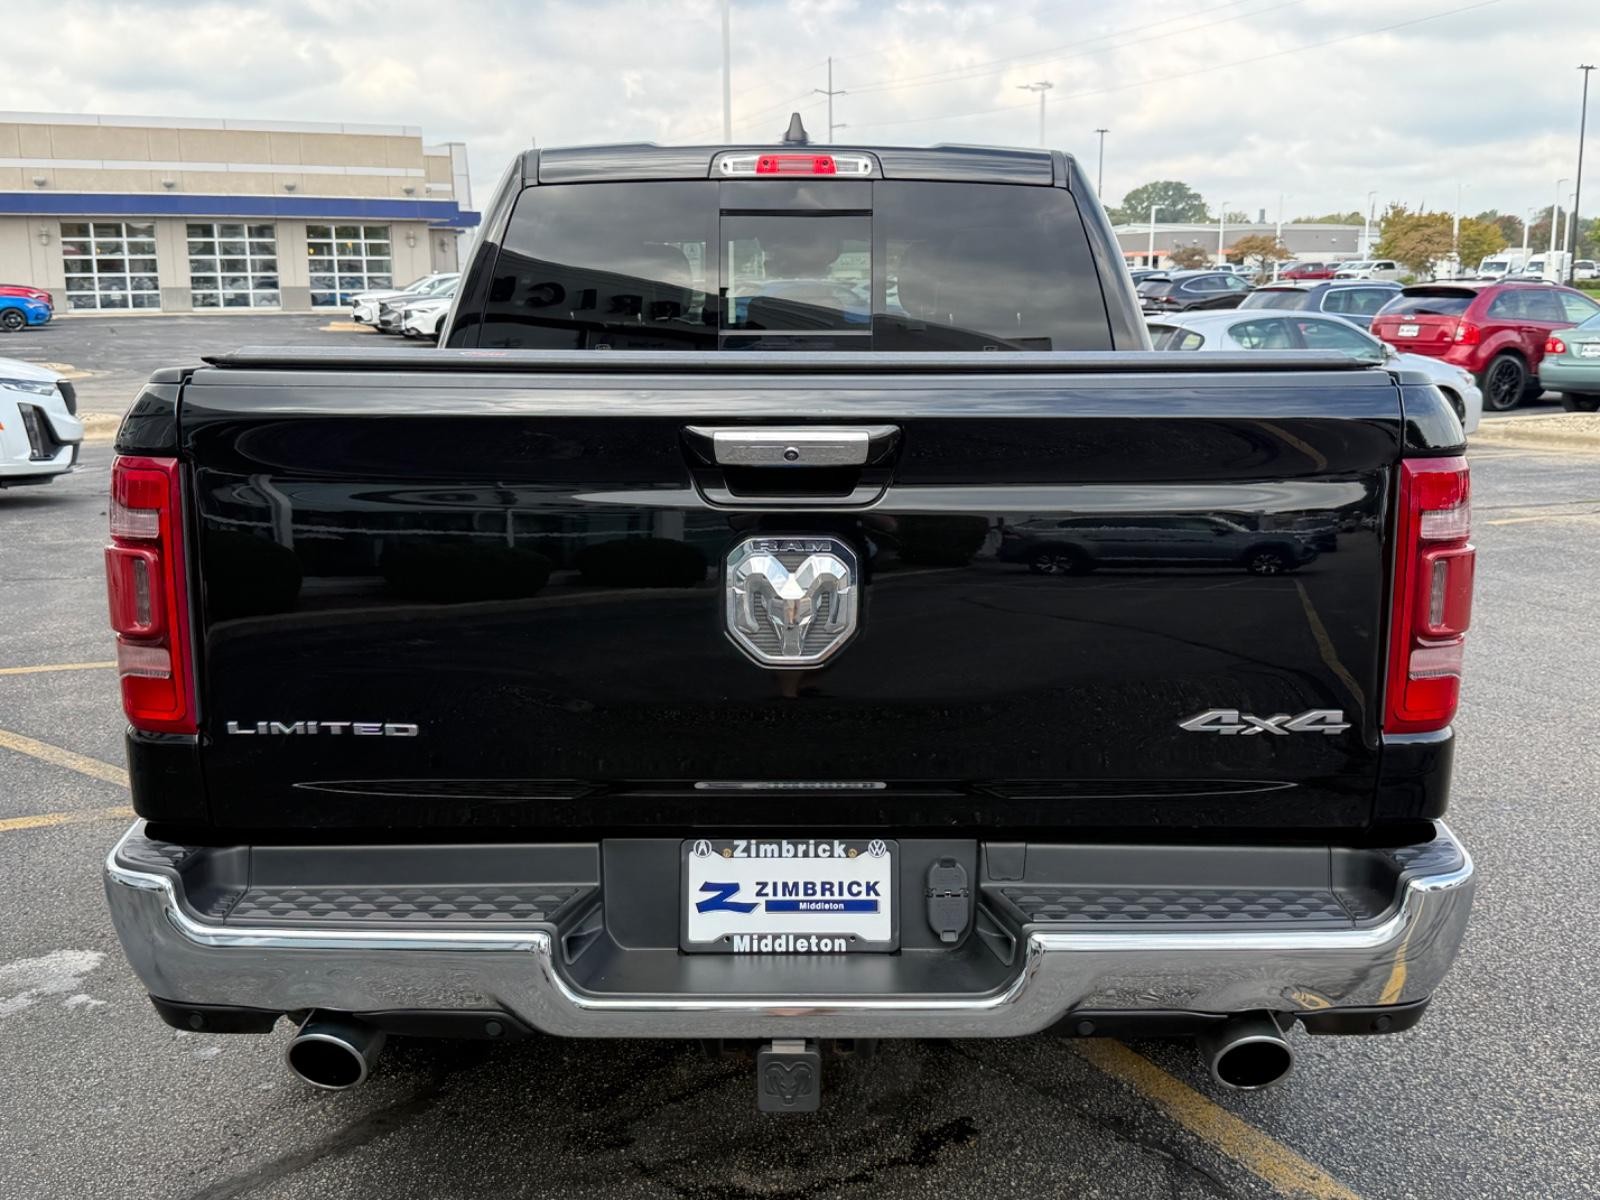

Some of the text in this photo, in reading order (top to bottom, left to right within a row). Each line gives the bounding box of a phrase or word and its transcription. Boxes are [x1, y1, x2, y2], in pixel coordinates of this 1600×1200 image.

[750, 541, 832, 552] RAM
[227, 721, 418, 736] LIMITED
[733, 839, 847, 858] Zimbrick
[755, 880, 881, 897] ZIMBRICK
[799, 901, 845, 911] Middleton
[733, 934, 848, 953] Middleton
